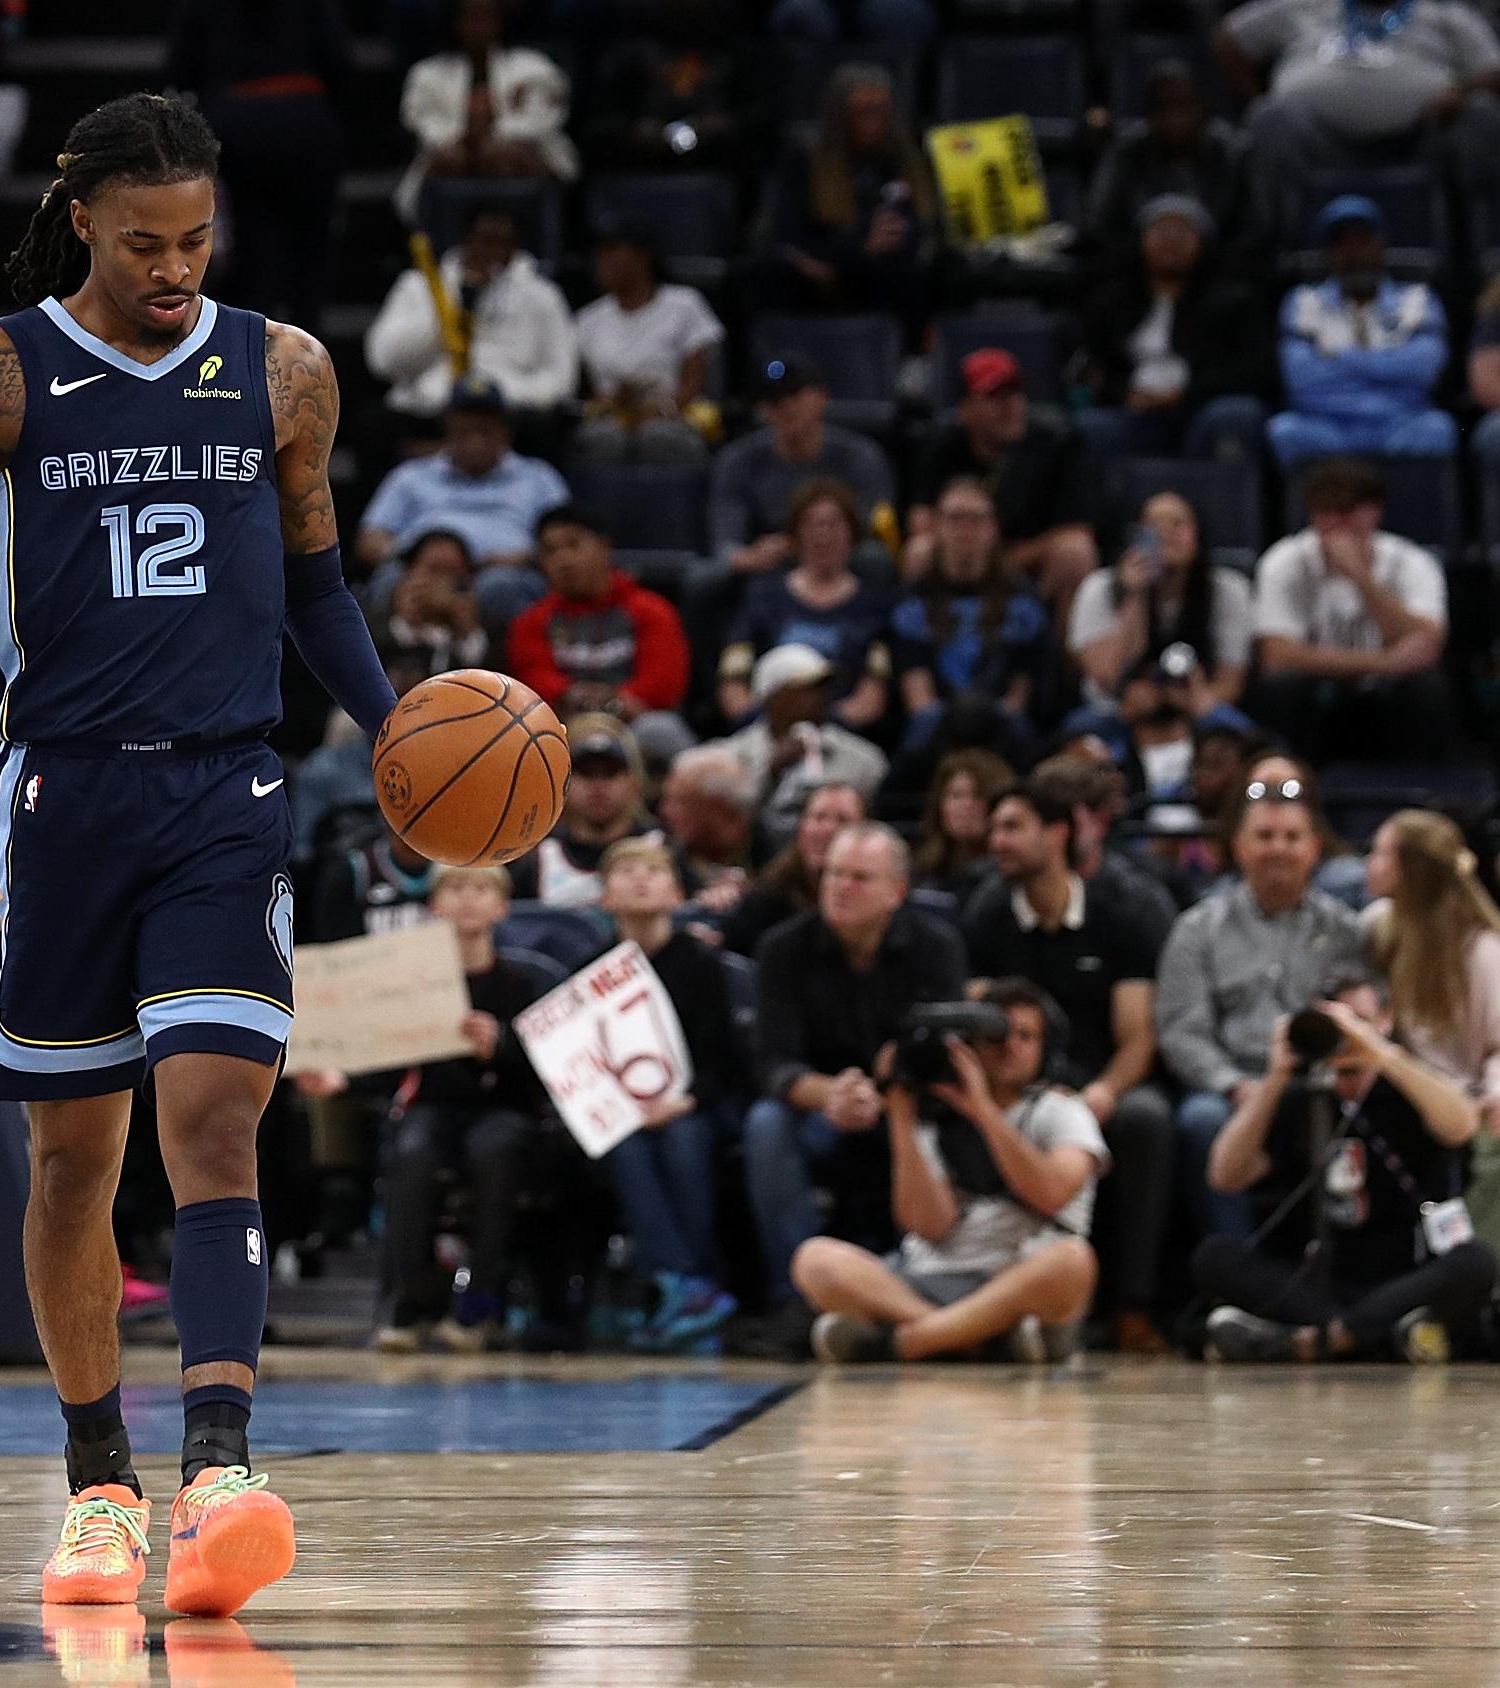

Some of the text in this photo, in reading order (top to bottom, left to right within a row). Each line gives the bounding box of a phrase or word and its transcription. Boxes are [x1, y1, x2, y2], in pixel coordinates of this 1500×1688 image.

[183, 387, 242, 400] Robinhood
[40, 445, 263, 490] GRIZZLIES
[100, 503, 207, 598] 12
